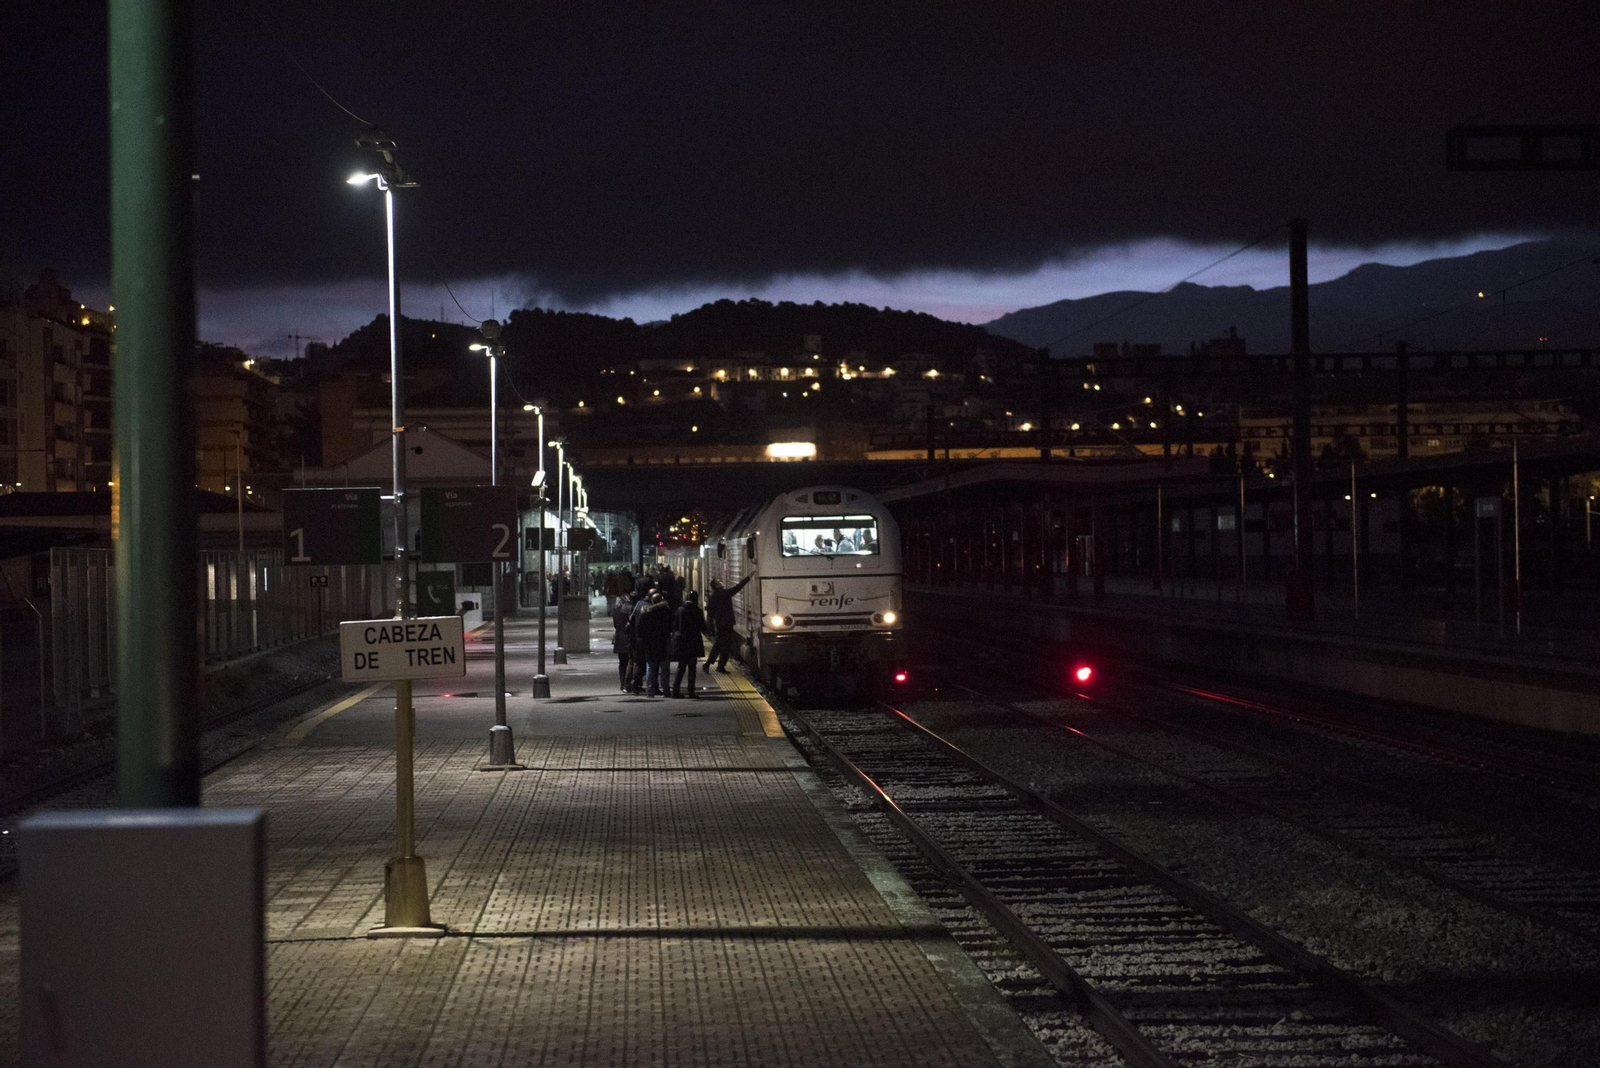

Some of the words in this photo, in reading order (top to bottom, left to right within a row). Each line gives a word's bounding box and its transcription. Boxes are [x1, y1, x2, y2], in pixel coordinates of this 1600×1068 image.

[290, 528, 311, 562] 1
[491, 524, 510, 558] 2
[528, 539, 534, 550] 1
[588, 539, 594, 550] 2
[810, 594, 854, 610] renfe
[365, 624, 442, 644] CABEZA
[354, 652, 379, 669] DE
[405, 647, 455, 667] TREN
